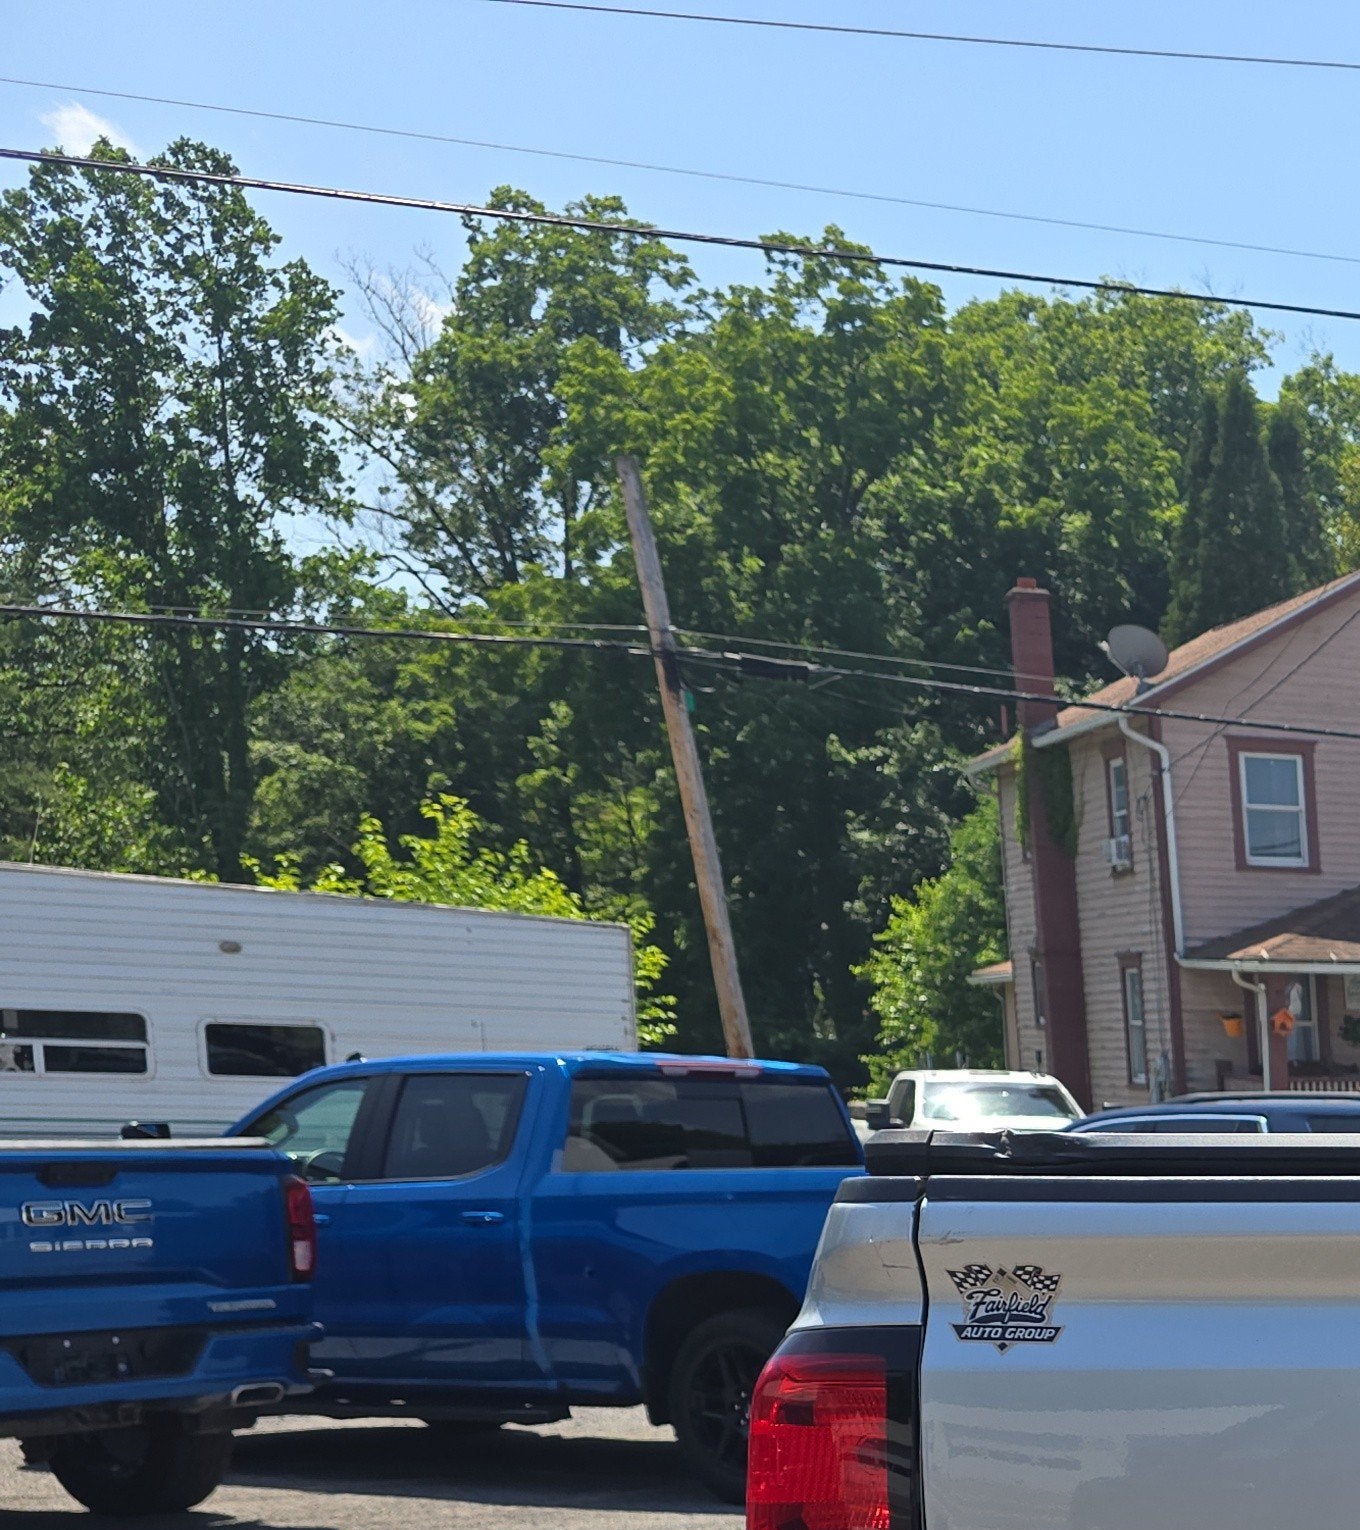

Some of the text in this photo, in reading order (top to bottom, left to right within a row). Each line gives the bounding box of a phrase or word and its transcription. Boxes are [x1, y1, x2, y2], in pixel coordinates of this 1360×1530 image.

[21, 1198, 154, 1227] GMC
[966, 1289, 1052, 1324] Fairfield
[960, 1326, 1056, 1339] AUTO GROUP
